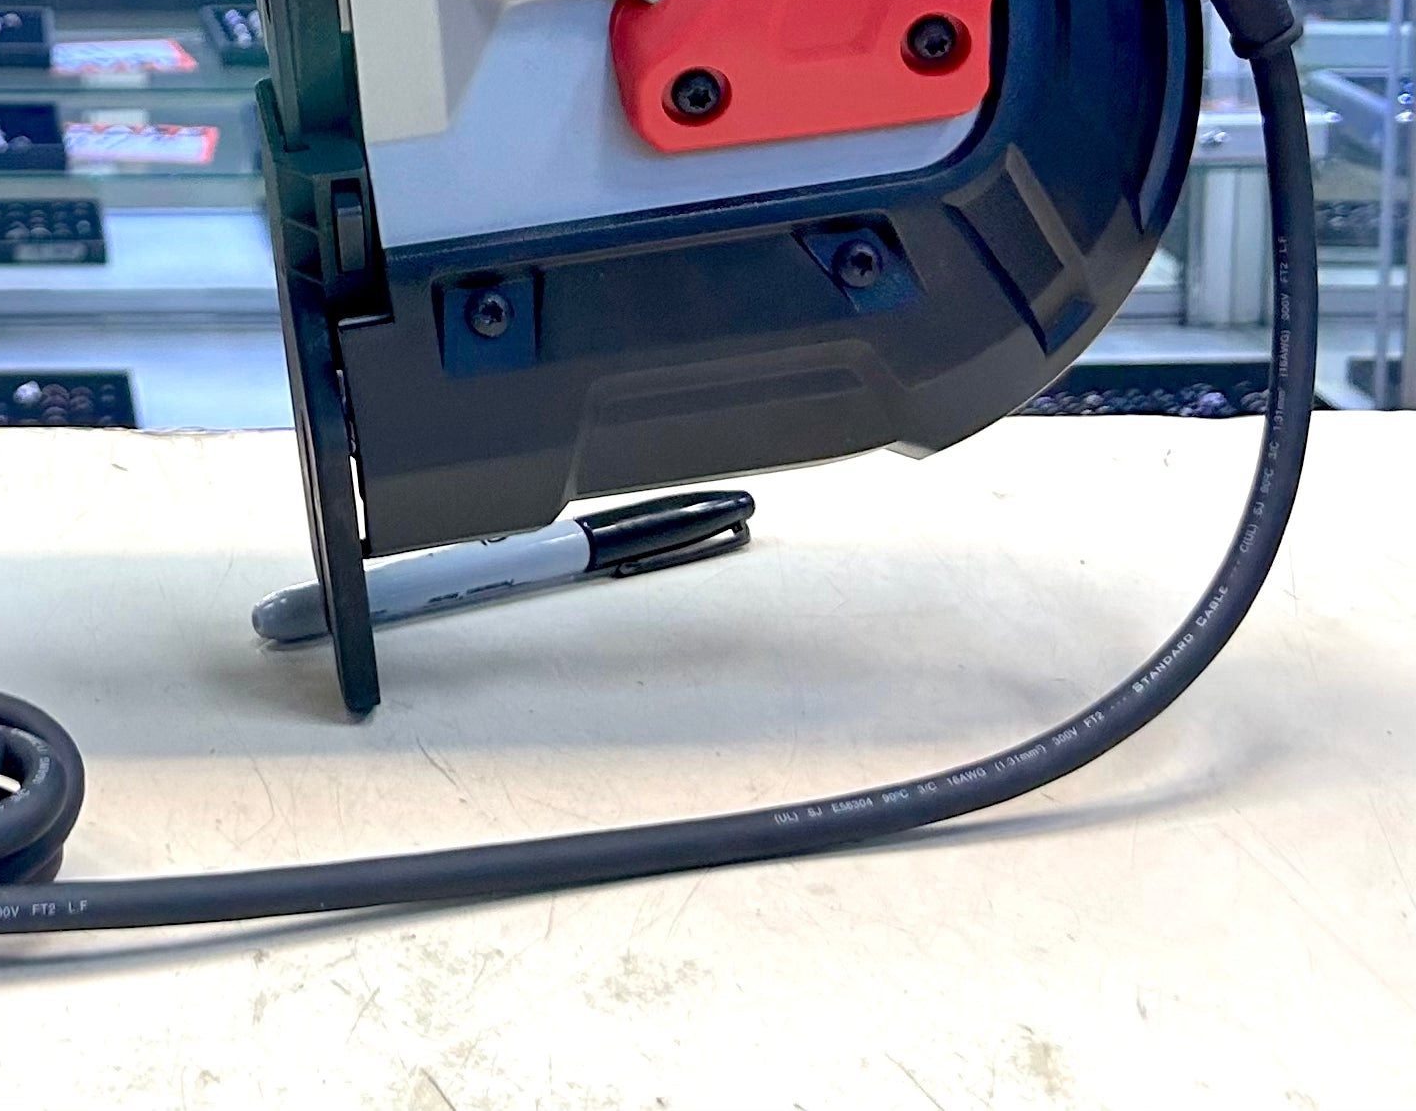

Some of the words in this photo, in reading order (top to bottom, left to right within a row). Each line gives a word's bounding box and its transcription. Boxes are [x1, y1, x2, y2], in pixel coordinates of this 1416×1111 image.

[774, 812, 799, 825] (UL)
[807, 807, 823, 818] SJ
[946, 767, 988, 787] 16AWG
[1083, 710, 1105, 728] FT2
[1132, 633, 1194, 693] STANDARD
[1195, 585, 1229, 627] CABLE
[32, 902, 56, 917] FT2
